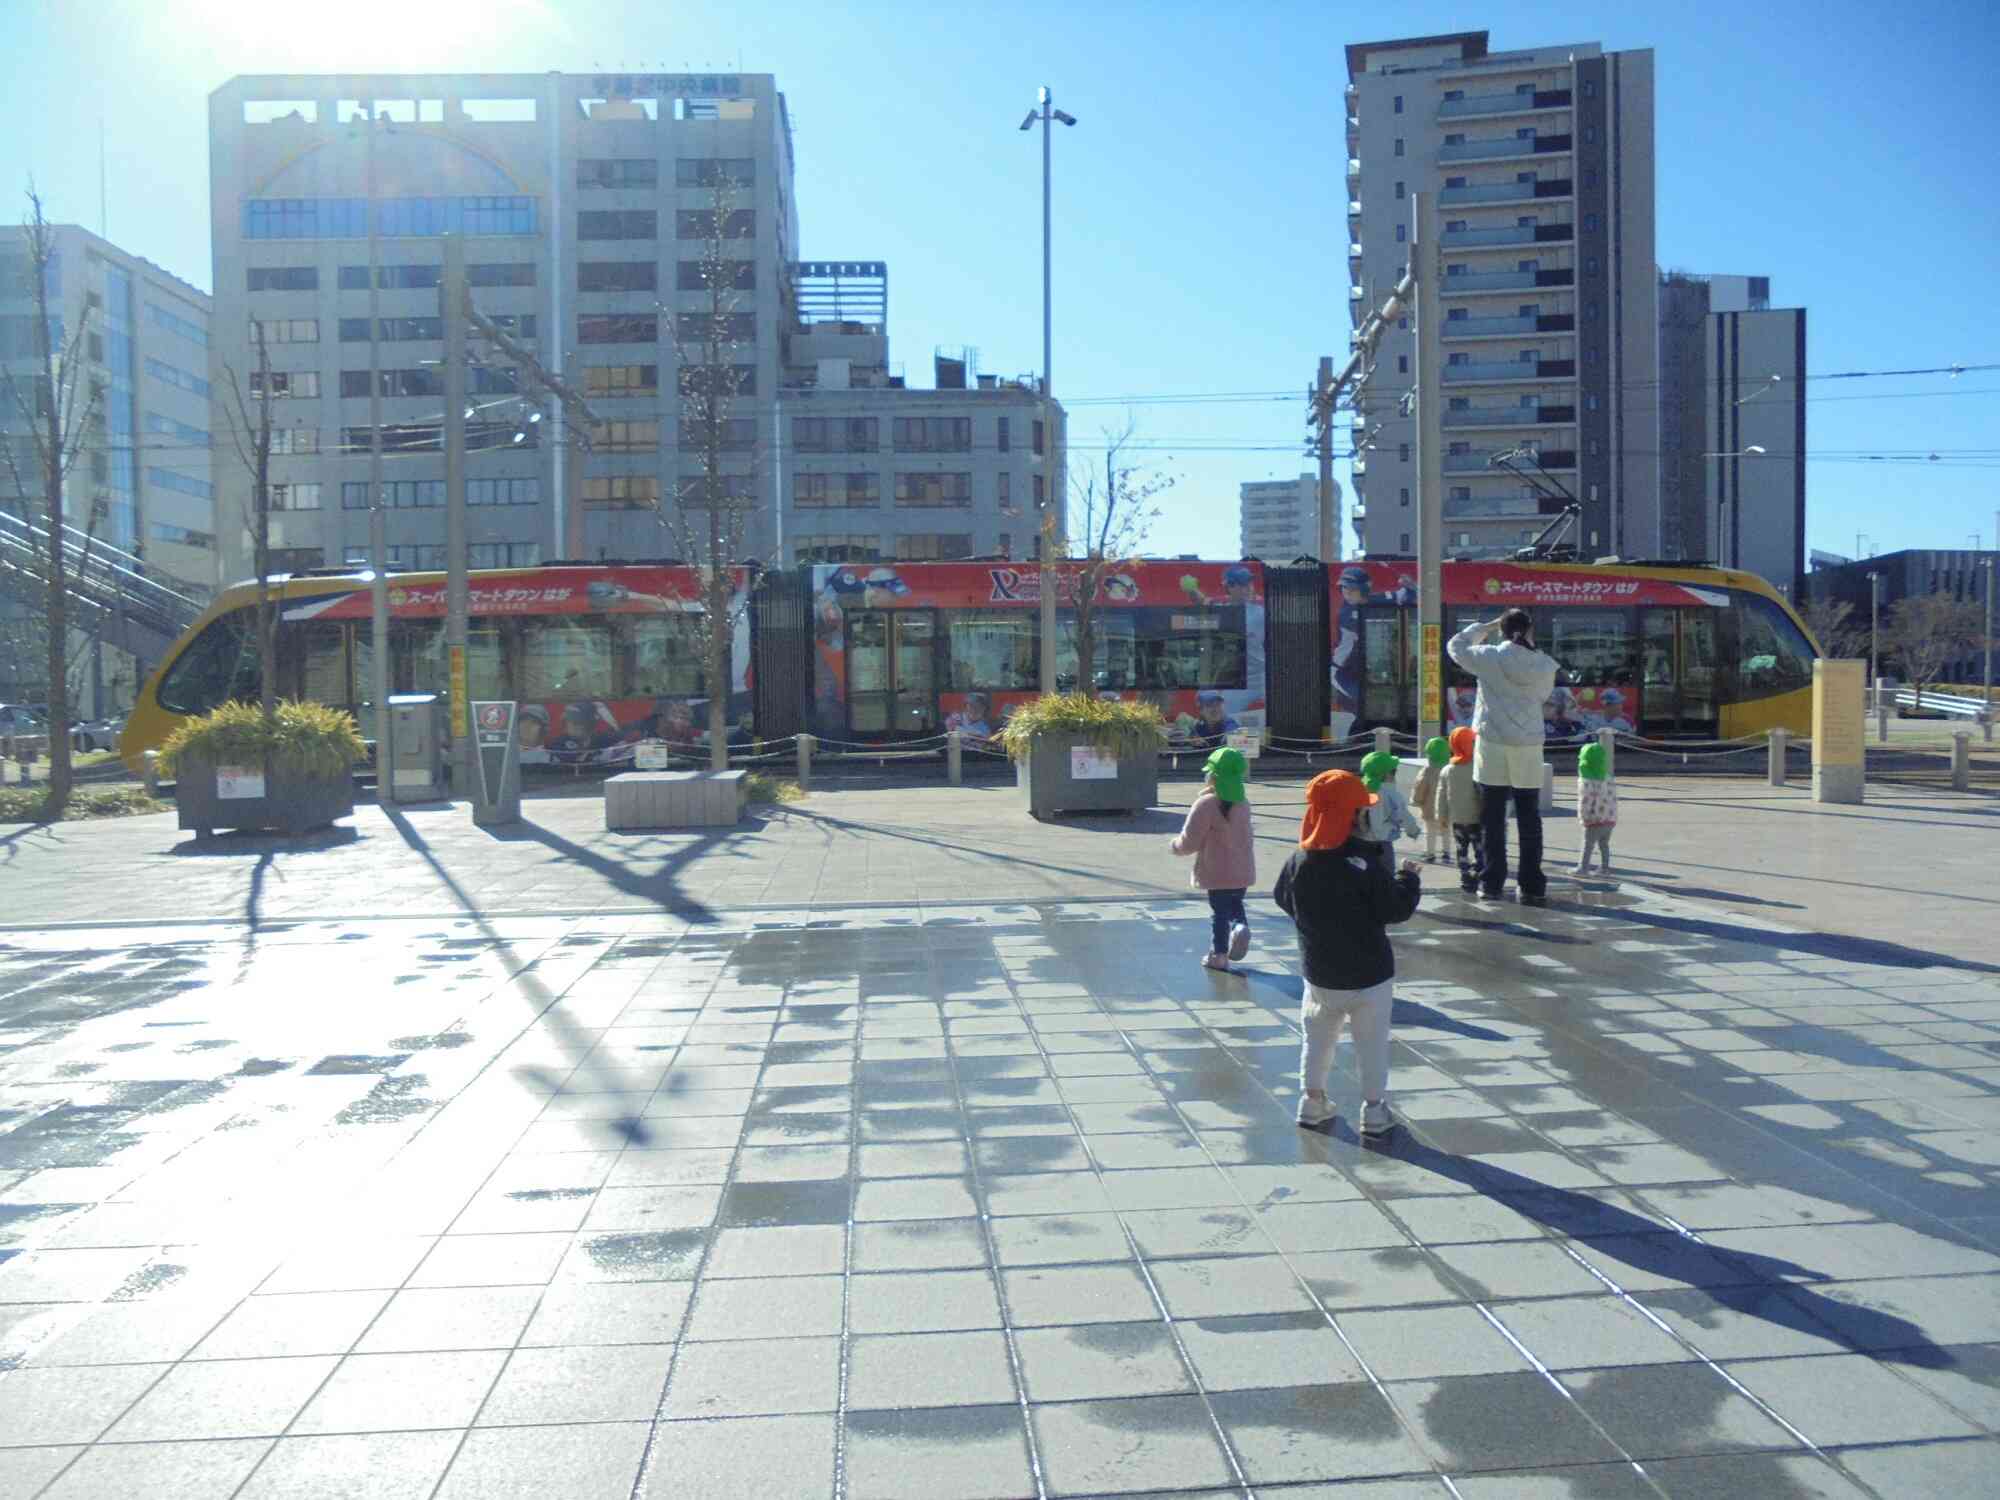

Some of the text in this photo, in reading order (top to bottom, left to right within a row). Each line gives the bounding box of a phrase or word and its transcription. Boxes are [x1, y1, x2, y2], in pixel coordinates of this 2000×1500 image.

[410, 589, 541, 602] スーパマートタウン
